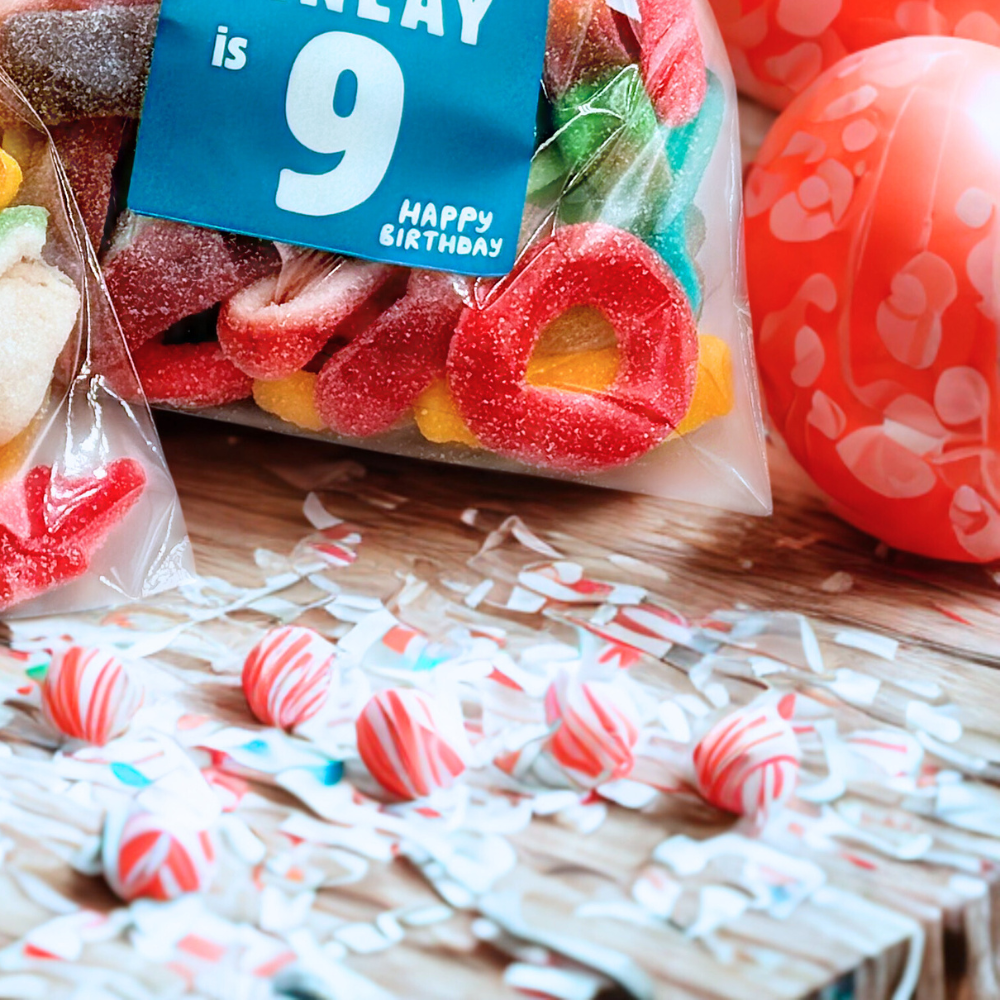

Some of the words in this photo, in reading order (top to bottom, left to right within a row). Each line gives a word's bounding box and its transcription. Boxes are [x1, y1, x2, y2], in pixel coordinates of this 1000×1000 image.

[210, 25, 248, 71] is
[275, 30, 405, 217] 9
[398, 198, 493, 235] HAPPY
[378, 222, 503, 258] BIRTHDAY
